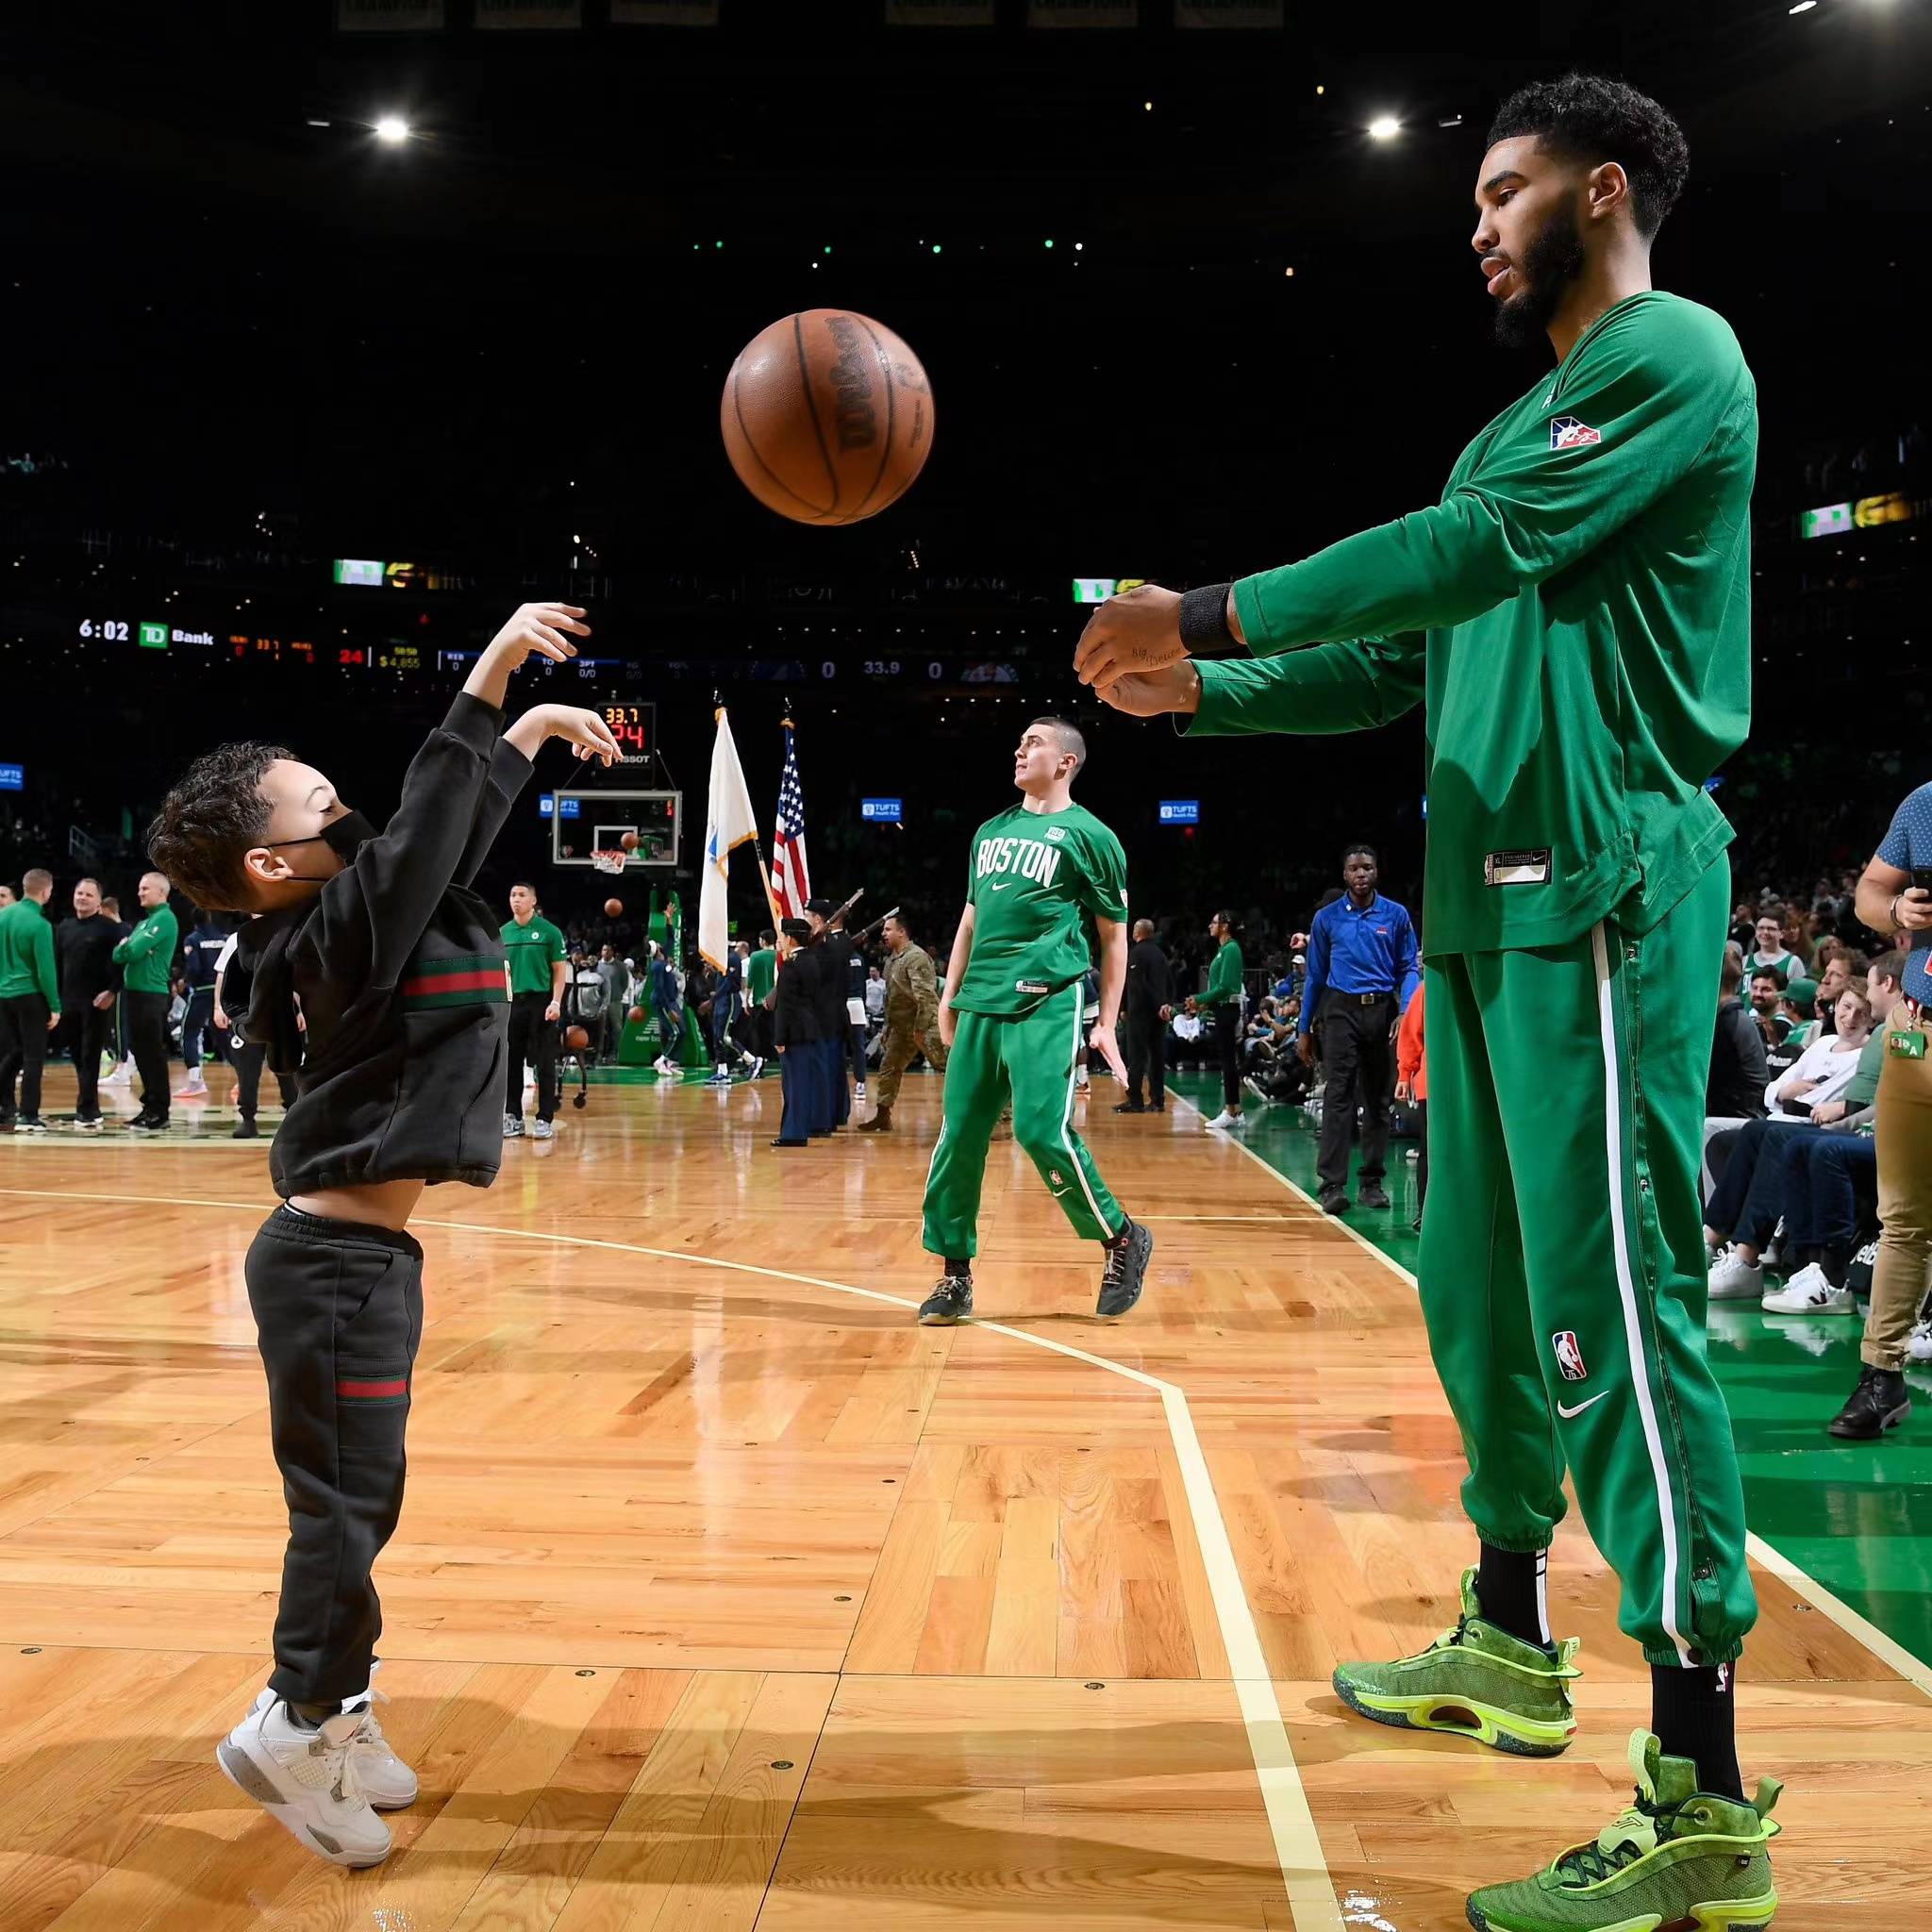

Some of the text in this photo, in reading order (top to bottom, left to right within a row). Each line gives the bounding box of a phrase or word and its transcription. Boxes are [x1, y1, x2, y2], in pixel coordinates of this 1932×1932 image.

[79, 619, 129, 641] 6:02
[142, 626, 165, 643] TD
[172, 629, 214, 645] Bank
[340, 649, 363, 664] 24
[822, 661, 836, 679] 0
[863, 661, 901, 675] 33.9
[928, 662, 942, 679] 0
[606, 708, 639, 724] 33.7
[976, 837, 1061, 889] BOSTON
